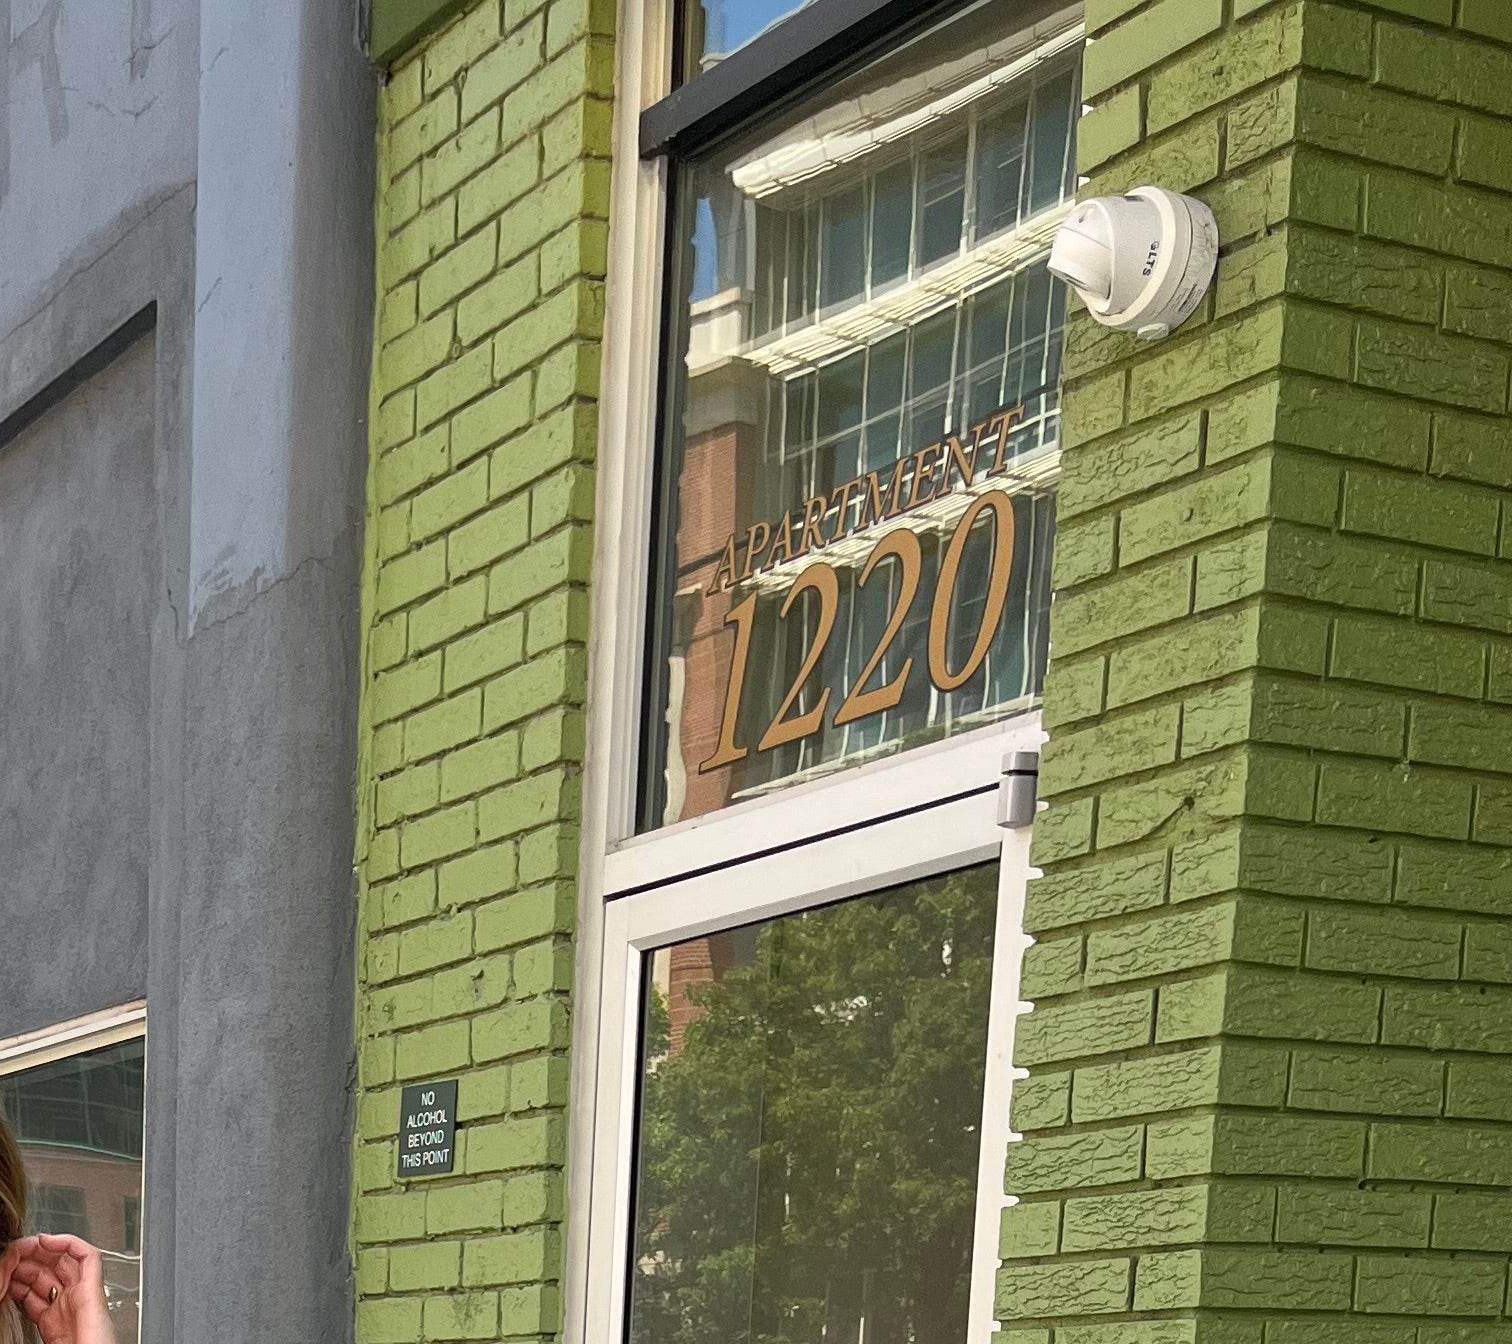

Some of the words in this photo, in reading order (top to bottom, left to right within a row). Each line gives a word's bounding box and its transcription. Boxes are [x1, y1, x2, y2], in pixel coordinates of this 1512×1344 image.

[705, 404, 1026, 597] APARTMENT
[698, 489, 1016, 775] 1220
[421, 1091, 435, 1106] NO
[406, 1109, 448, 1129] ALCOHOL
[407, 1130, 445, 1148] BEYOND
[401, 1153, 422, 1169] THIS
[422, 1149, 450, 1166] POINT
